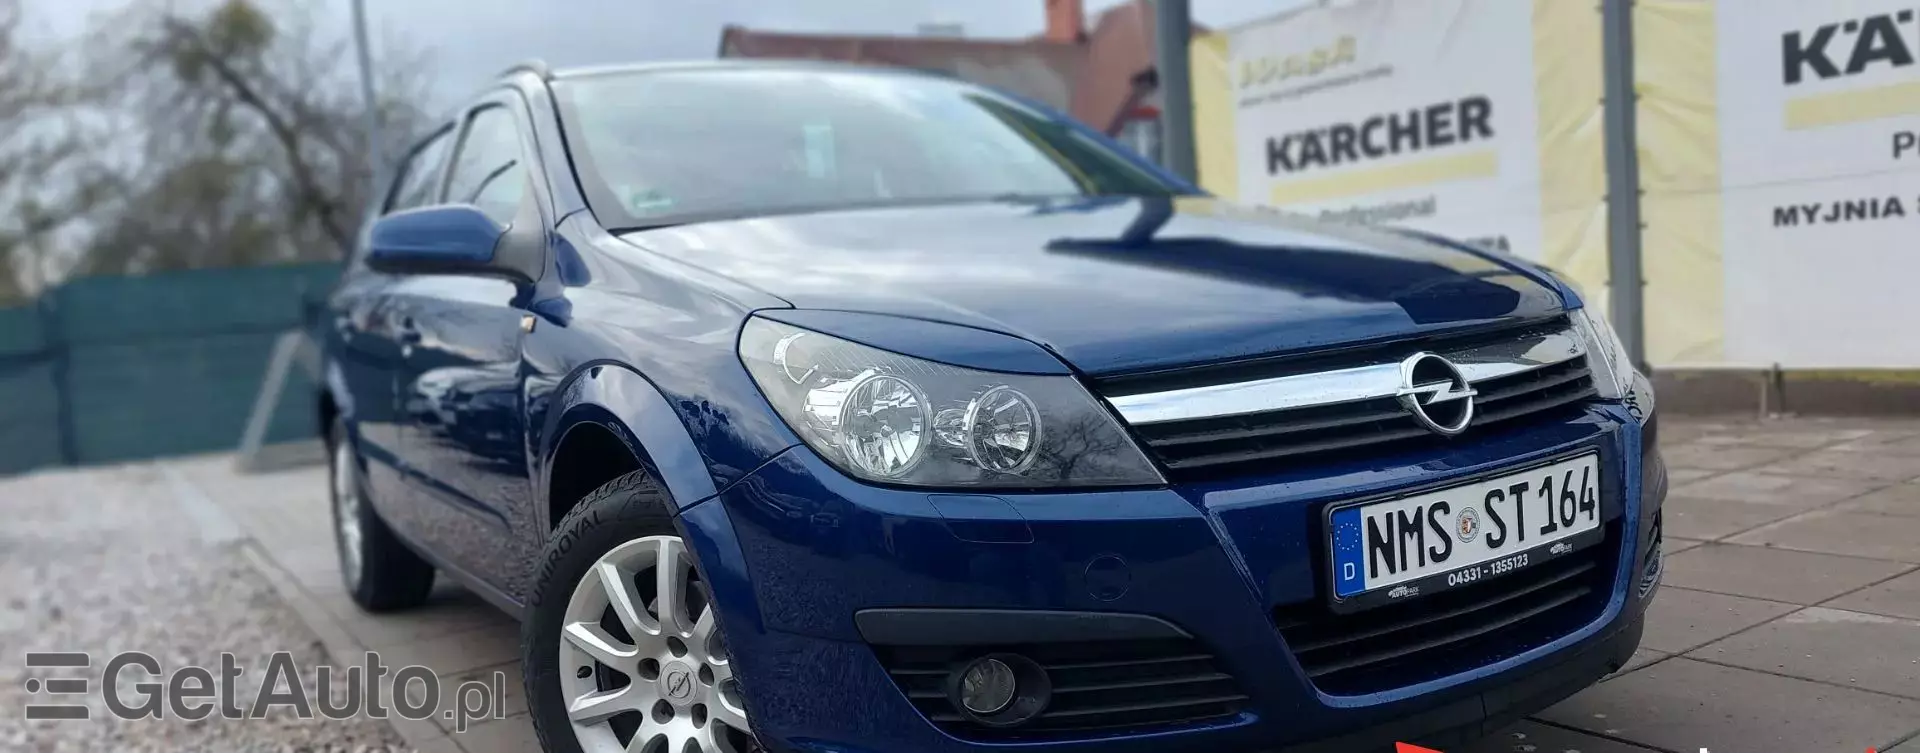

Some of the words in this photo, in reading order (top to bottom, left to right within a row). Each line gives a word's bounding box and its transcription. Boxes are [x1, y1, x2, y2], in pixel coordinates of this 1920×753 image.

[1266, 95, 1494, 175] KÄRCHER
[1892, 131, 1920, 160] P
[1773, 196, 1906, 227] MYJNIA
[1367, 500, 1453, 579] NMS
[1484, 482, 1530, 550] ST
[1538, 465, 1596, 537] 164
[531, 510, 603, 607] UNIROYAL
[1343, 562, 1356, 581] D
[1448, 566, 1482, 587] 04331
[1491, 553, 1530, 577] 1355123
